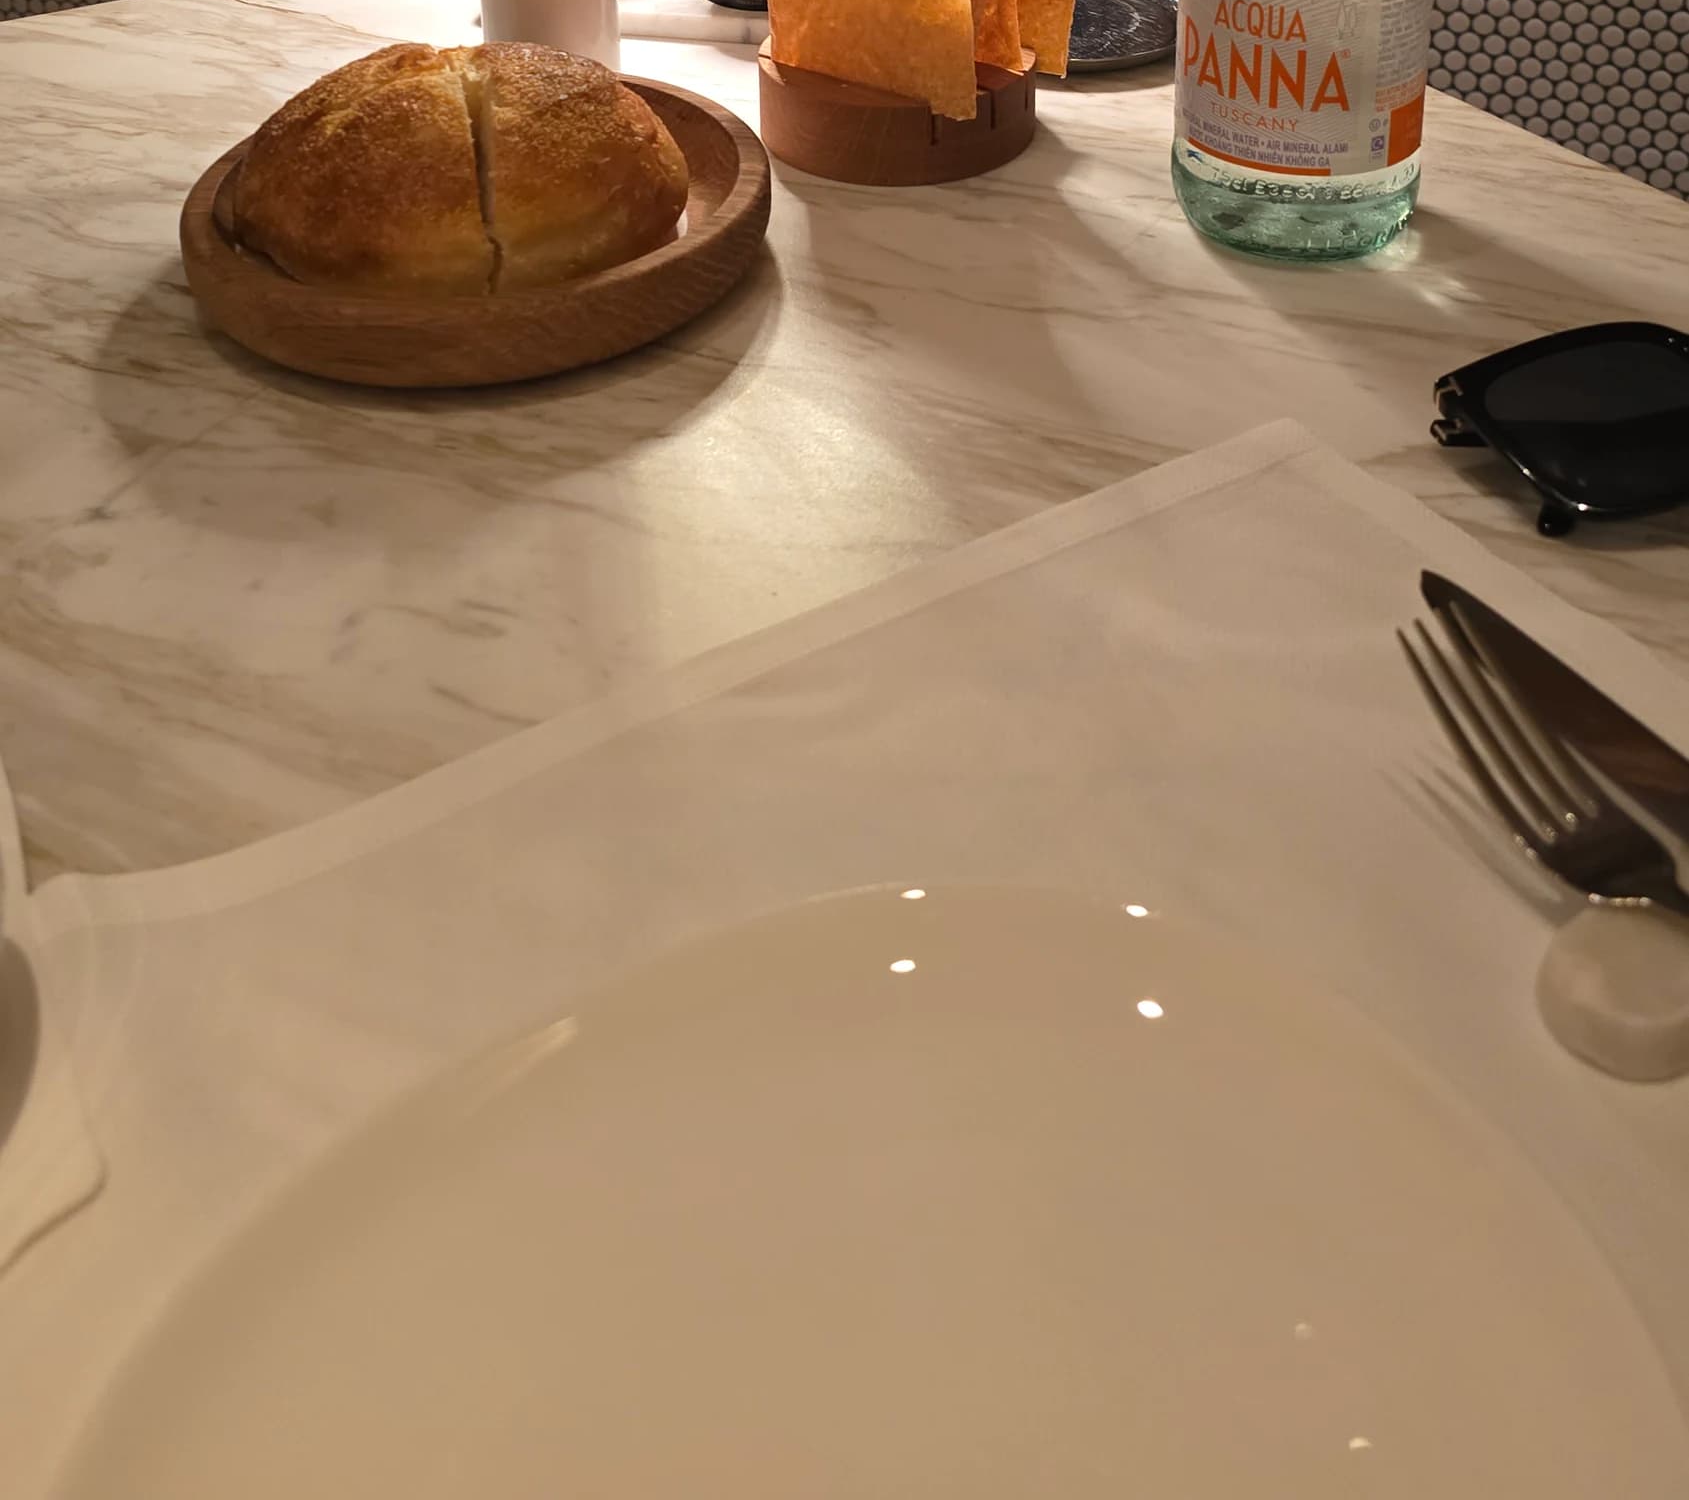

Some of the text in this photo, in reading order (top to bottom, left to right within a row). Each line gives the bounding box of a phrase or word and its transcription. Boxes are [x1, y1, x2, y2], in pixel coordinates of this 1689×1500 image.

[1184, 15, 1350, 112] PANNA
[1211, 101, 1298, 132] TUSCANY
[1203, 121, 1230, 141] MINERAL
[1232, 131, 1260, 148] WATER
[1266, 139, 1281, 150] AIR
[1283, 141, 1320, 154] MINERAL
[1322, 142, 1349, 155] ALAMI
[1318, 156, 1330, 167] GA
